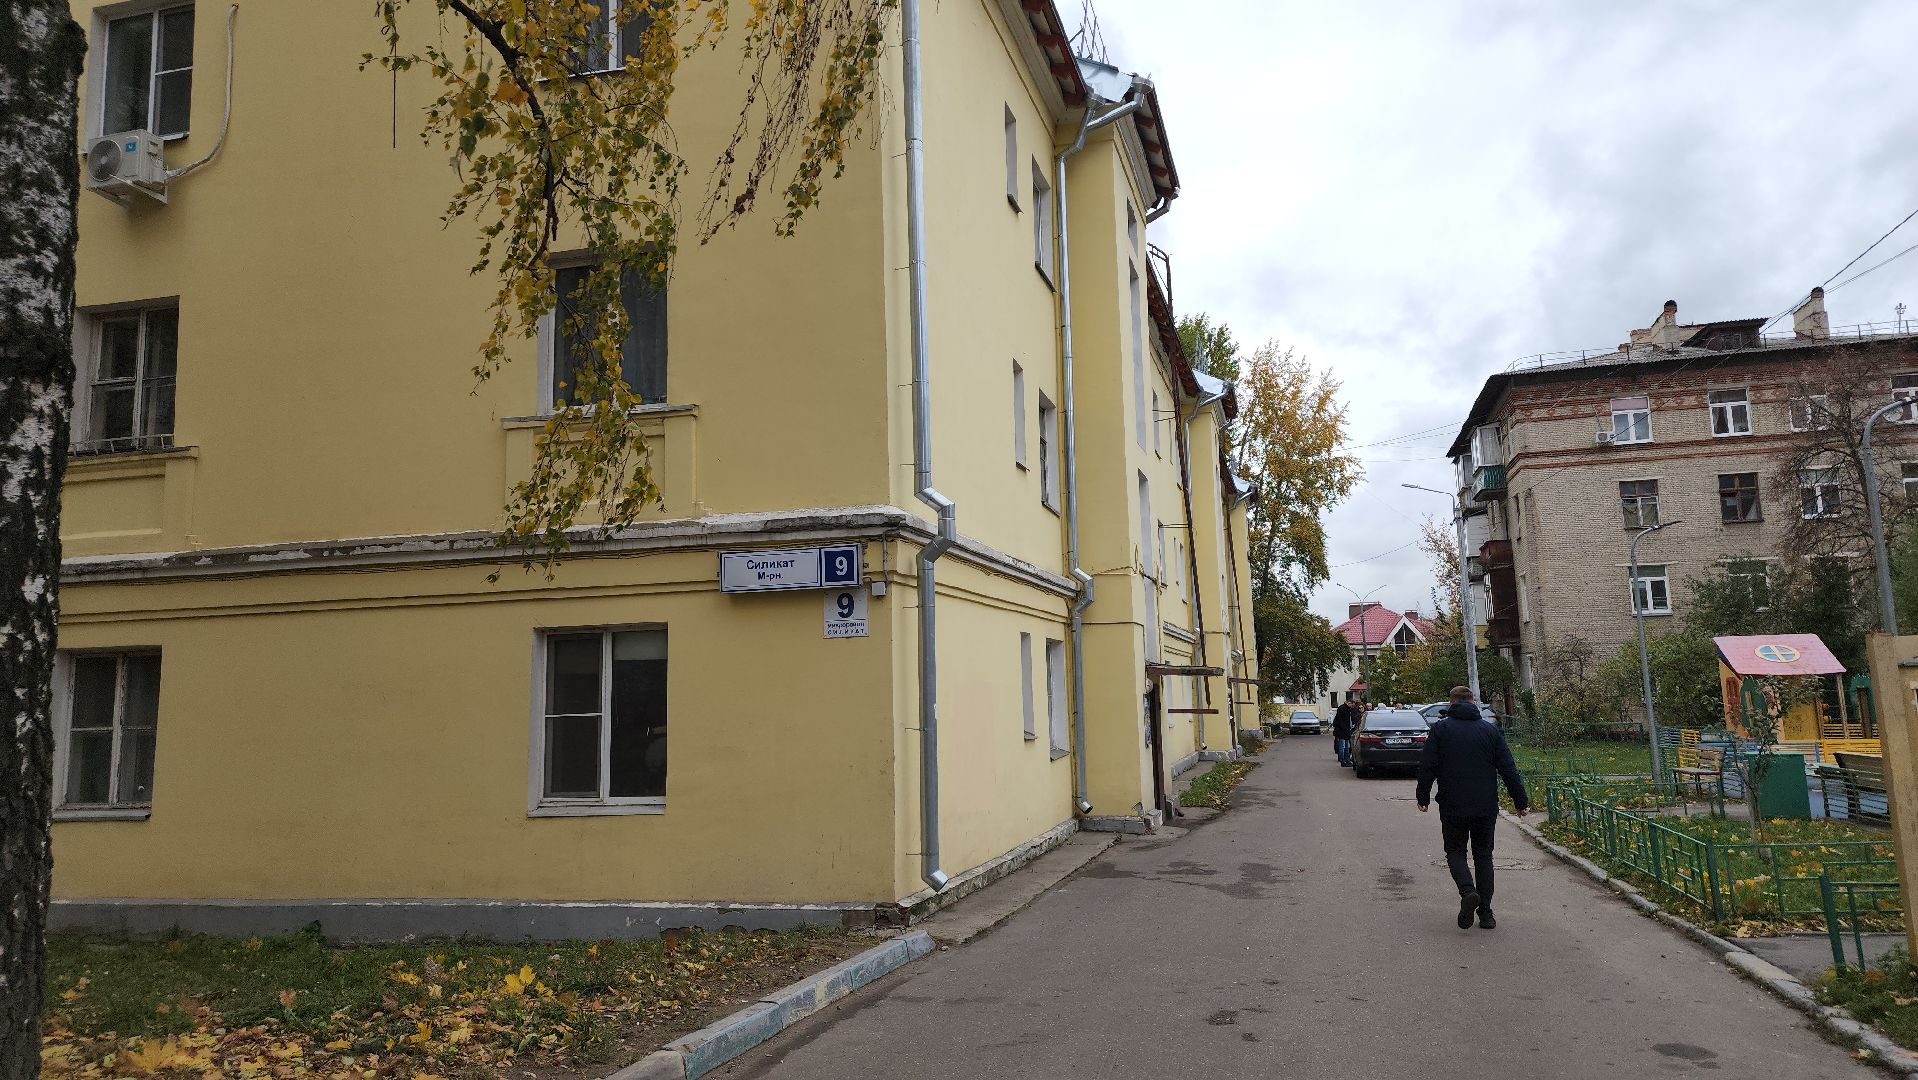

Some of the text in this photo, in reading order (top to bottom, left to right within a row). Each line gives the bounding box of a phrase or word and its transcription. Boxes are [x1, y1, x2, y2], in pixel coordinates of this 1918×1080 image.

[746, 559, 795, 570] Силикат
[835, 556, 848, 576] 9
[757, 571, 784, 582] М-рн.
[836, 592, 855, 619] 9
